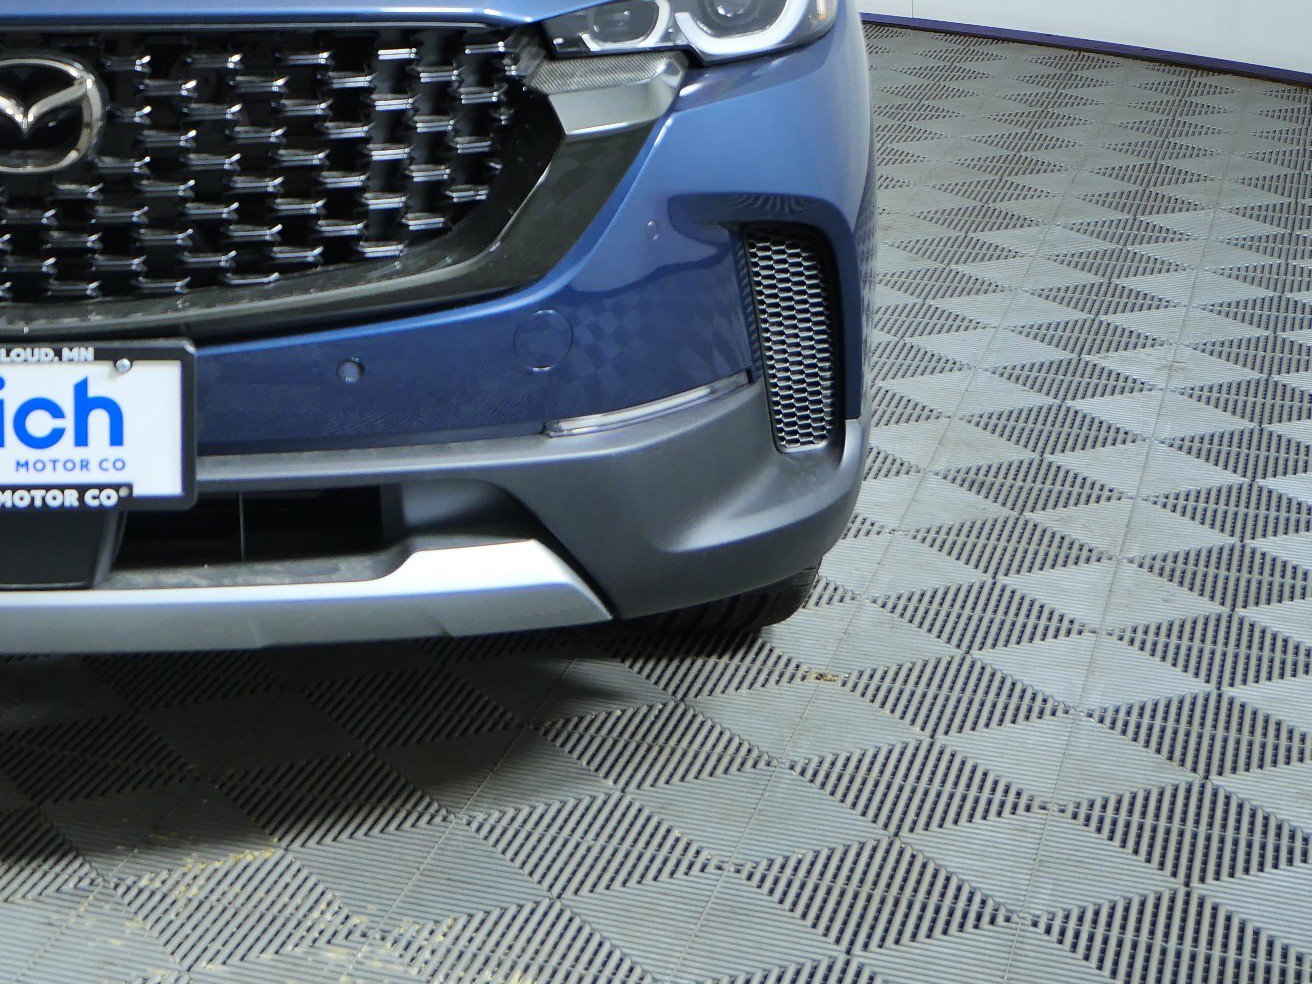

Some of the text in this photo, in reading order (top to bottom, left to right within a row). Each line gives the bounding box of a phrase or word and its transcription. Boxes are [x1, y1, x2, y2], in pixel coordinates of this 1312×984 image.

[62, 347, 94, 362] MN
[15, 458, 126, 472] MOTOR CO
[84, 488, 118, 507] CO
